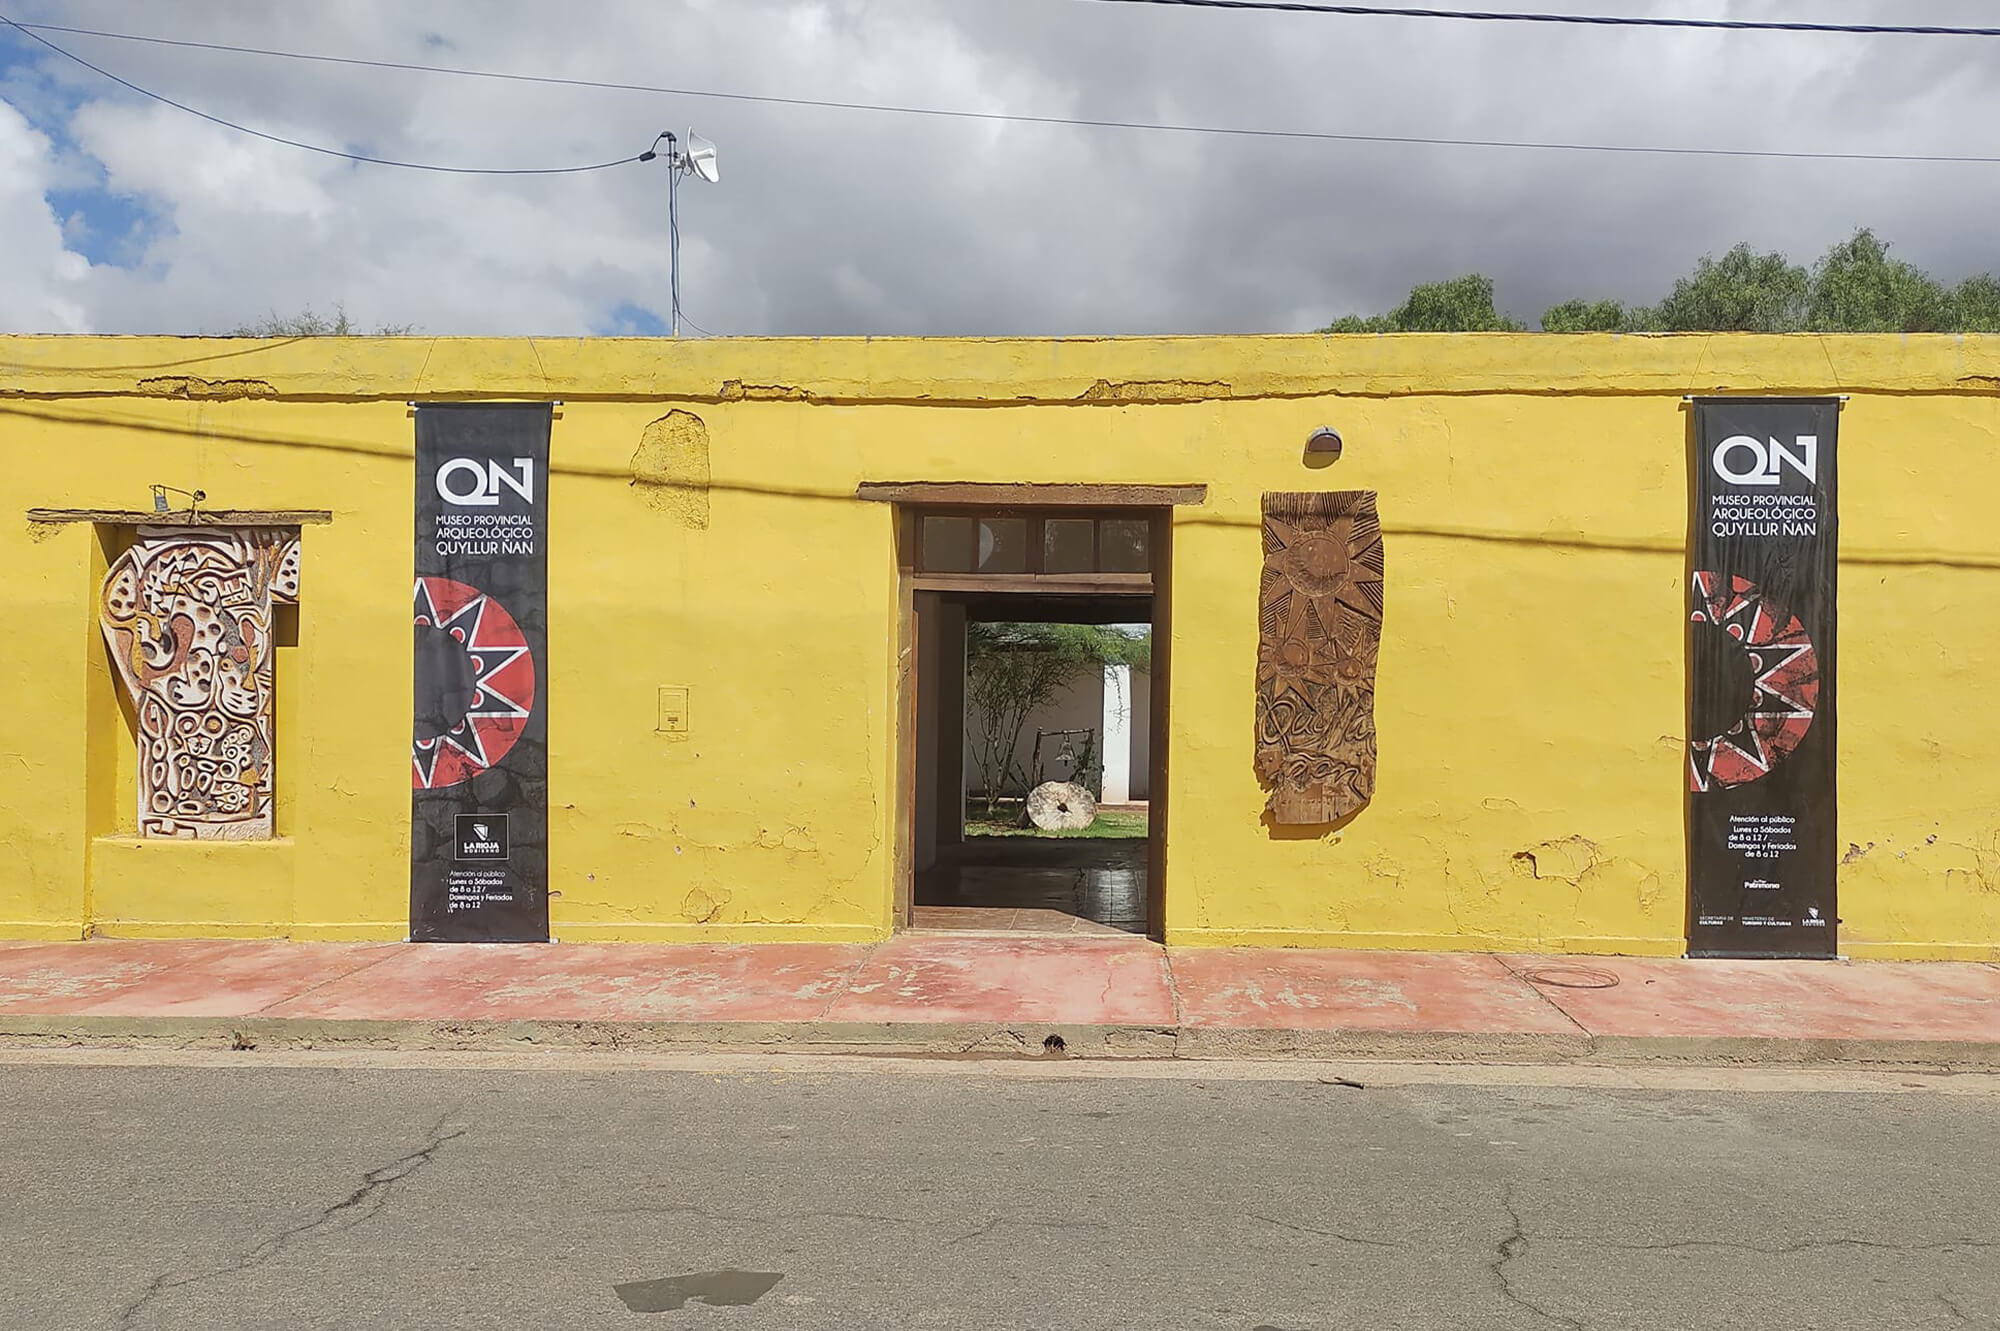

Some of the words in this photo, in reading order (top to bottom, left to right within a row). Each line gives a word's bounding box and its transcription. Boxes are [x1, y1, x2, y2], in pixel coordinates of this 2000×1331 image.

[1712, 495, 1751, 506] MUSEO
[1753, 495, 1816, 506] PROVINCIAL
[1712, 506, 1816, 520] ARQUEOLÓGICO
[436, 515, 472, 525] MUSEO
[473, 515, 533, 525] PROVINCIAL
[436, 526, 533, 539] ARQUEOLÓGICO
[1712, 522, 1779, 537] QUYLLUR
[1782, 520, 1816, 536] ÑAN
[436, 541, 498, 555] QUYLLUR
[502, 538, 533, 554] ÑAN
[1729, 815, 1760, 823] Atención
[1761, 815, 1768, 823] al
[1769, 815, 1796, 824] público
[1733, 825, 1752, 833] Lunes
[1760, 825, 1792, 834] Sábados
[1728, 841, 1761, 850] Domingos
[1761, 843, 1767, 851] y
[1767, 842, 1797, 850] Feriados
[1744, 850, 1755, 858] de
[1755, 850, 1762, 858] 8
[1769, 850, 1779, 858] 12
[449, 893, 480, 902] Domingos
[449, 901, 459, 909] de
[459, 901, 465, 909] 8
[471, 901, 481, 909] 12
